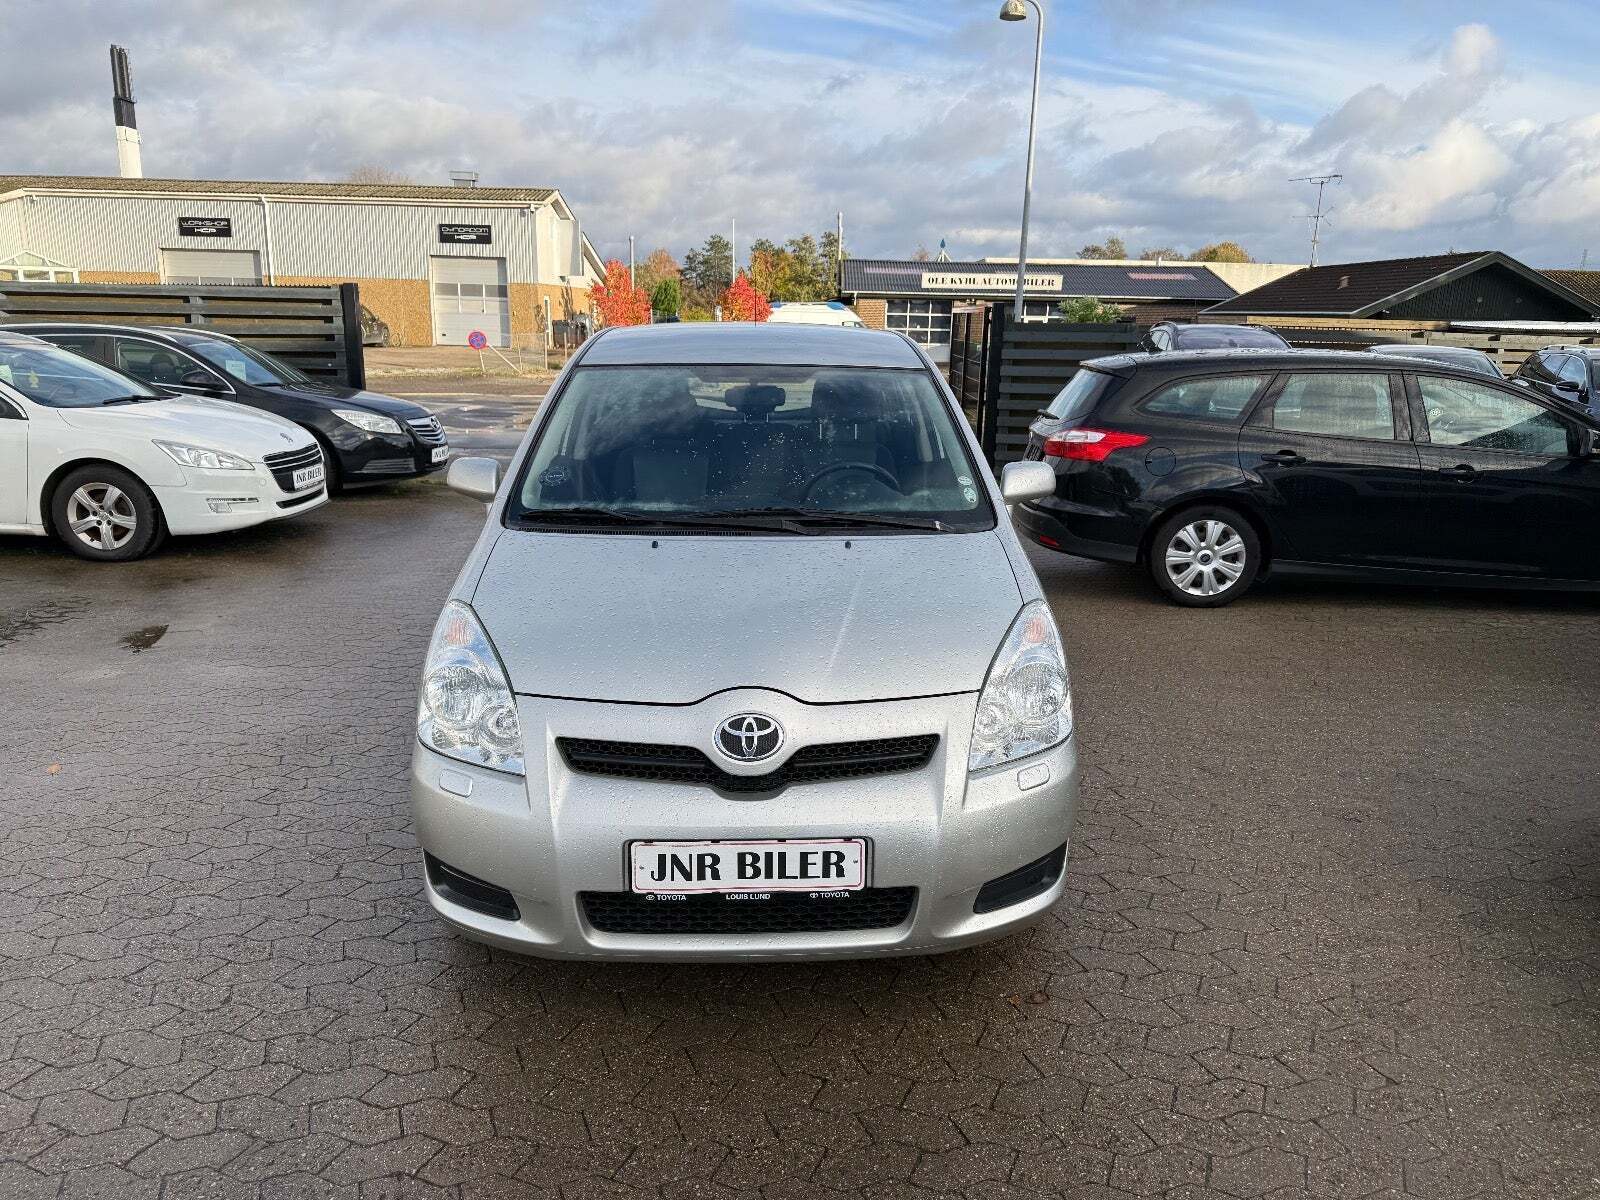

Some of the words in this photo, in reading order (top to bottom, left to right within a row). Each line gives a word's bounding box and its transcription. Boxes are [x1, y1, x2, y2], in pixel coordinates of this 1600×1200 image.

[928, 277, 947, 285] OLE
[981, 277, 1056, 287] AUTOMBILER
[650, 852, 722, 882] JNR
[736, 850, 847, 880] BILER
[820, 891, 850, 899] TOYOTA
